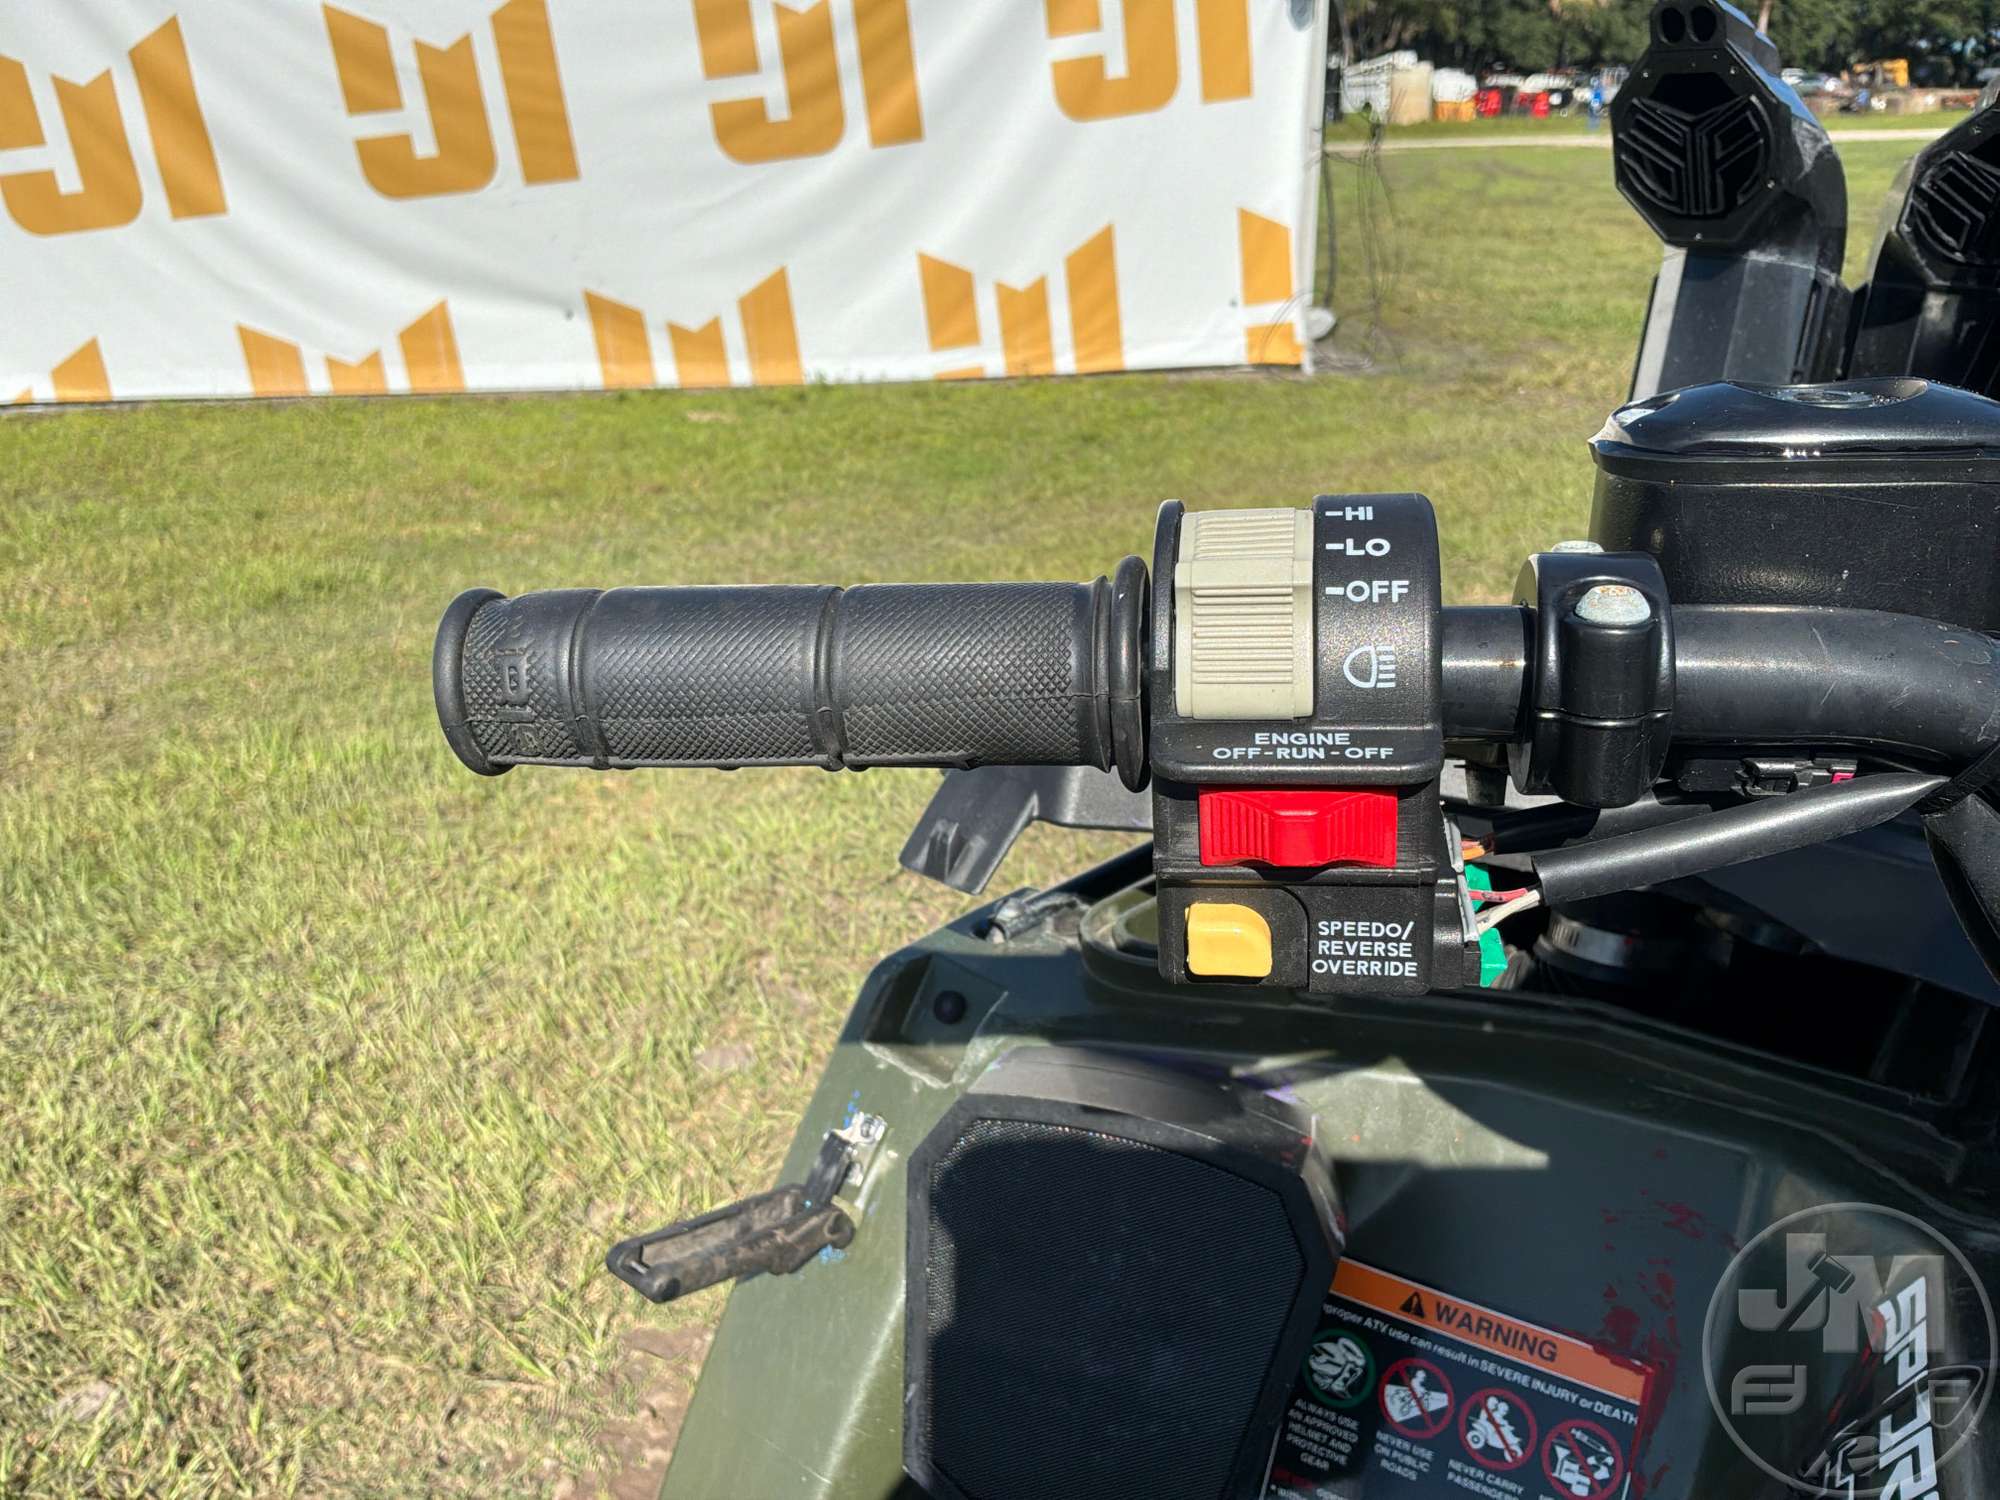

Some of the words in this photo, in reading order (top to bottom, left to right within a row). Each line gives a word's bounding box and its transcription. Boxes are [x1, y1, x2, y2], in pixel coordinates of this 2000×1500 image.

[1254, 732, 1350, 746] ENGINE
[1317, 920, 1415, 941] SPEEDO/
[1318, 940, 1412, 958] REVERSE
[1312, 959, 1418, 977] OVERRIDE
[1434, 1301, 1559, 1363] WARNING
[1363, 1317, 1390, 1336] ATV
[1389, 1327, 1410, 1343] use
[1410, 1335, 1432, 1350] can
[1432, 1343, 1467, 1364] result
[1467, 1354, 1479, 1370] in
[1480, 1358, 1532, 1388] SEVERE
[1531, 1377, 1578, 1405] INJURY
[1578, 1398, 1593, 1411] or
[1593, 1400, 1639, 1426] DEATH
[1876, 1276, 1940, 1500] SPOR
[1447, 1458, 1486, 1481] NEVER
[1485, 1472, 1525, 1495] CARRY
